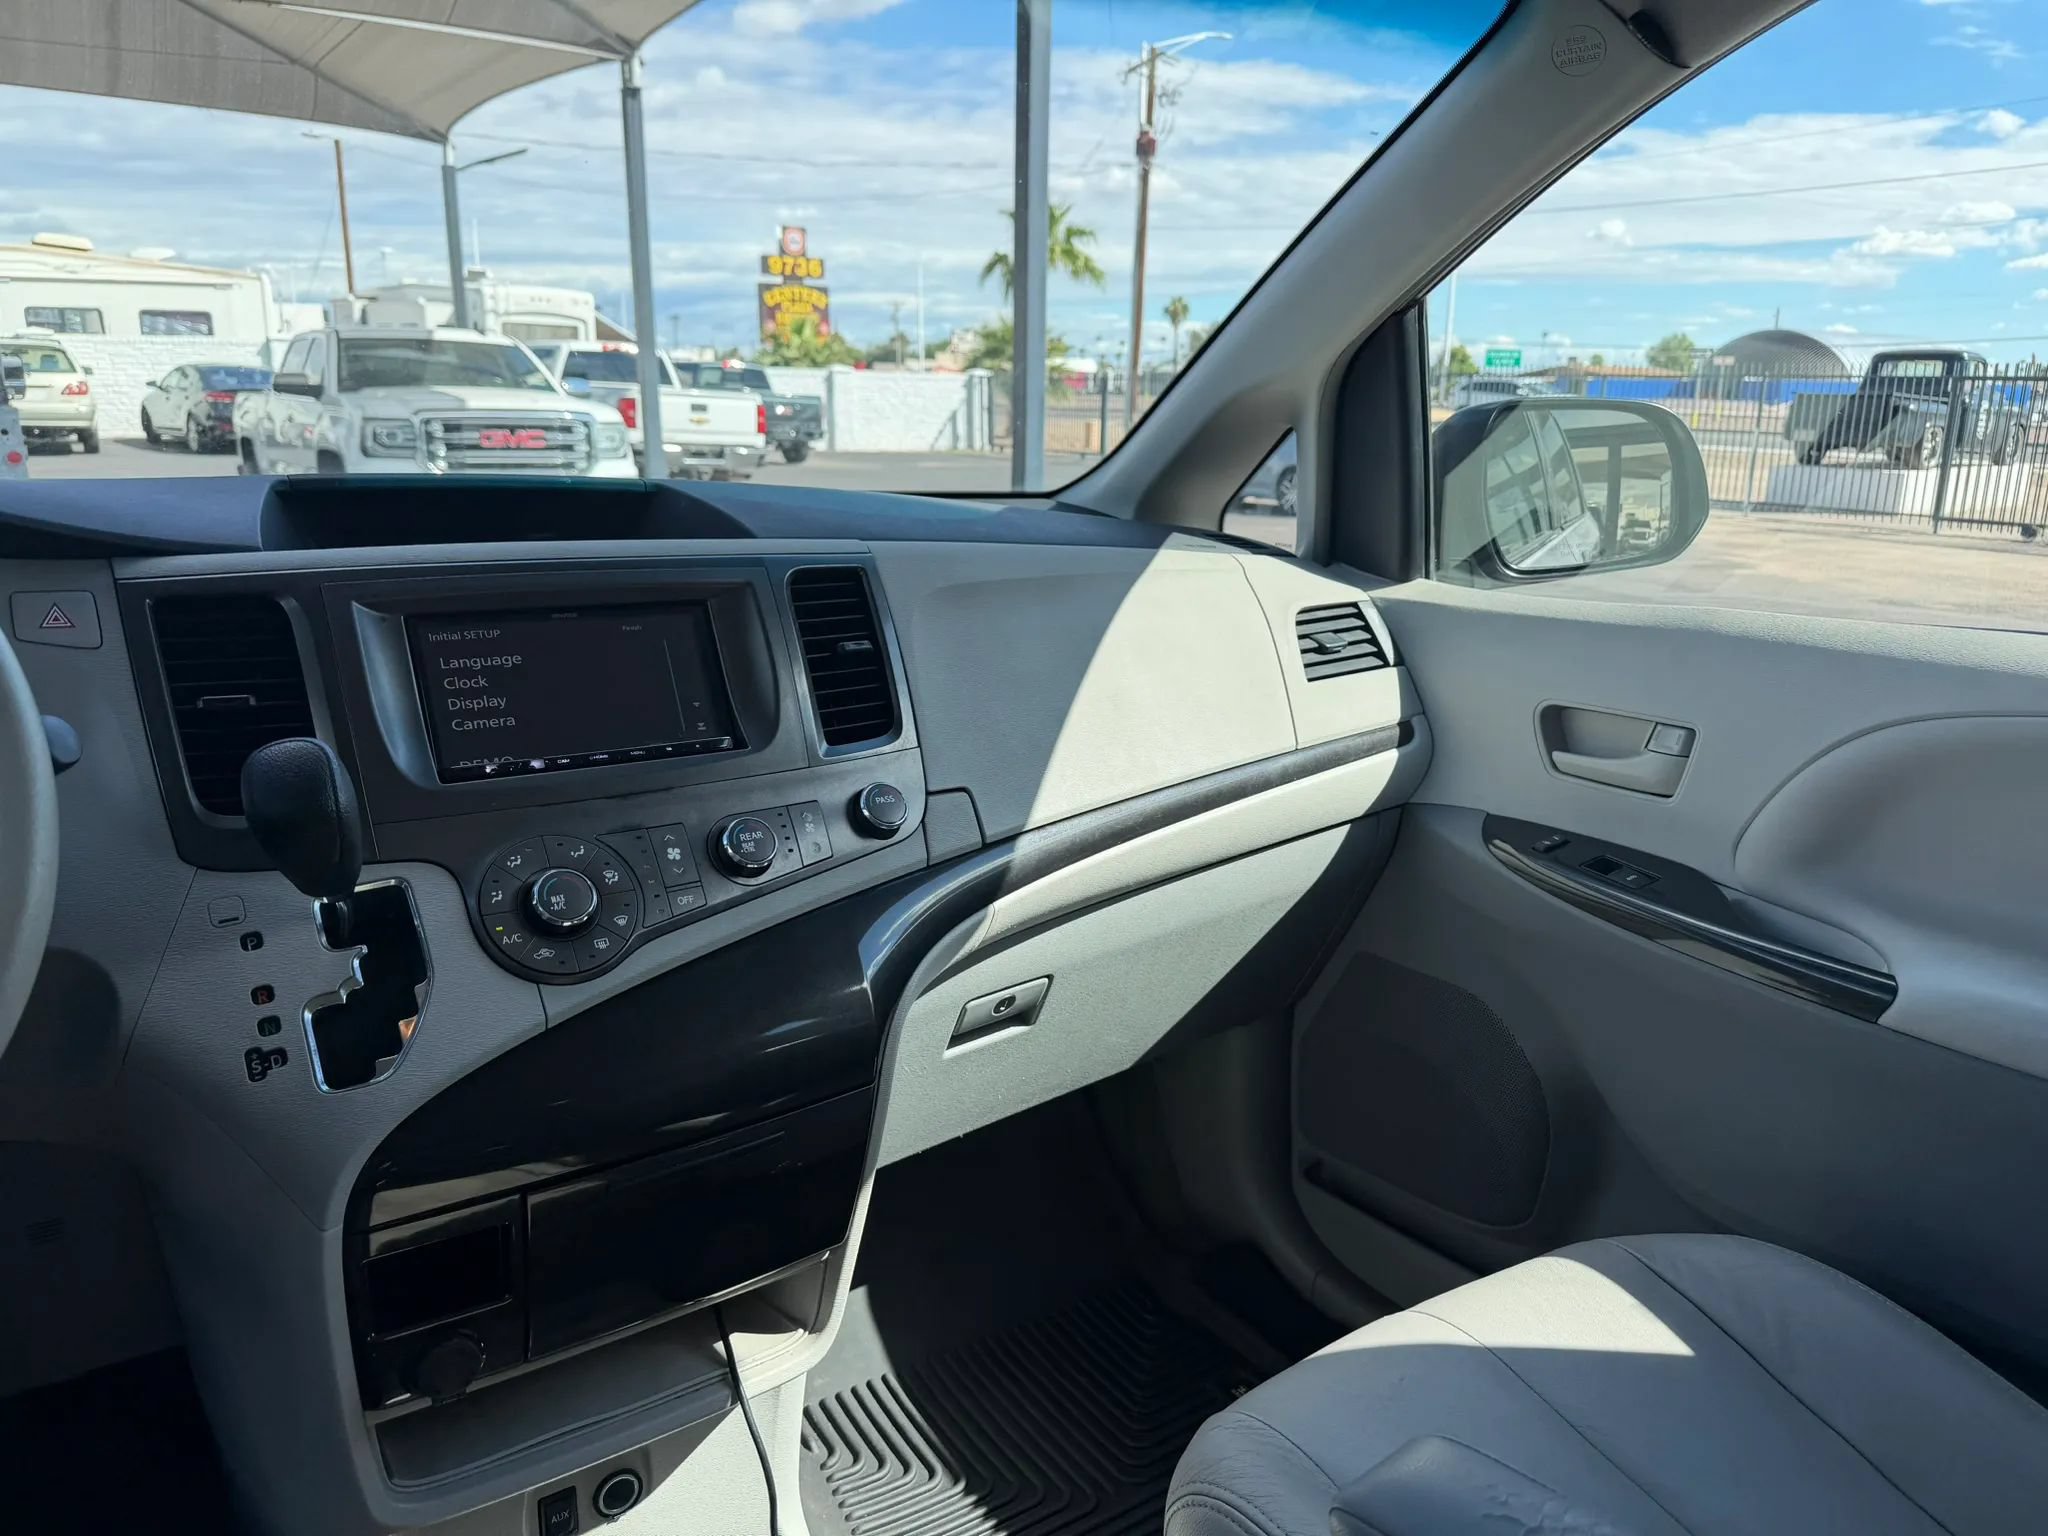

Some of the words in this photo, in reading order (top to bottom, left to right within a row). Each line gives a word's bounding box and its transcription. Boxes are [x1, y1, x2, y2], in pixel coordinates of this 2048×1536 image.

[479, 428, 547, 448] GMC
[428, 631, 462, 642] Initial
[463, 629, 501, 640] SETUP
[439, 654, 523, 670] Language
[443, 675, 489, 690] Clock
[447, 695, 507, 711] Display
[451, 714, 516, 732] Camera
[874, 795, 896, 804] PASS
[739, 831, 765, 842] REAR
[550, 894, 566, 904] MAX
[554, 902, 567, 911] A/C
[677, 895, 695, 905] OFF
[246, 935, 258, 950] P
[502, 933, 523, 945] A/C
[256, 989, 269, 1004] R
[263, 1021, 277, 1036] N
[551, 1510, 570, 1525] AUX
